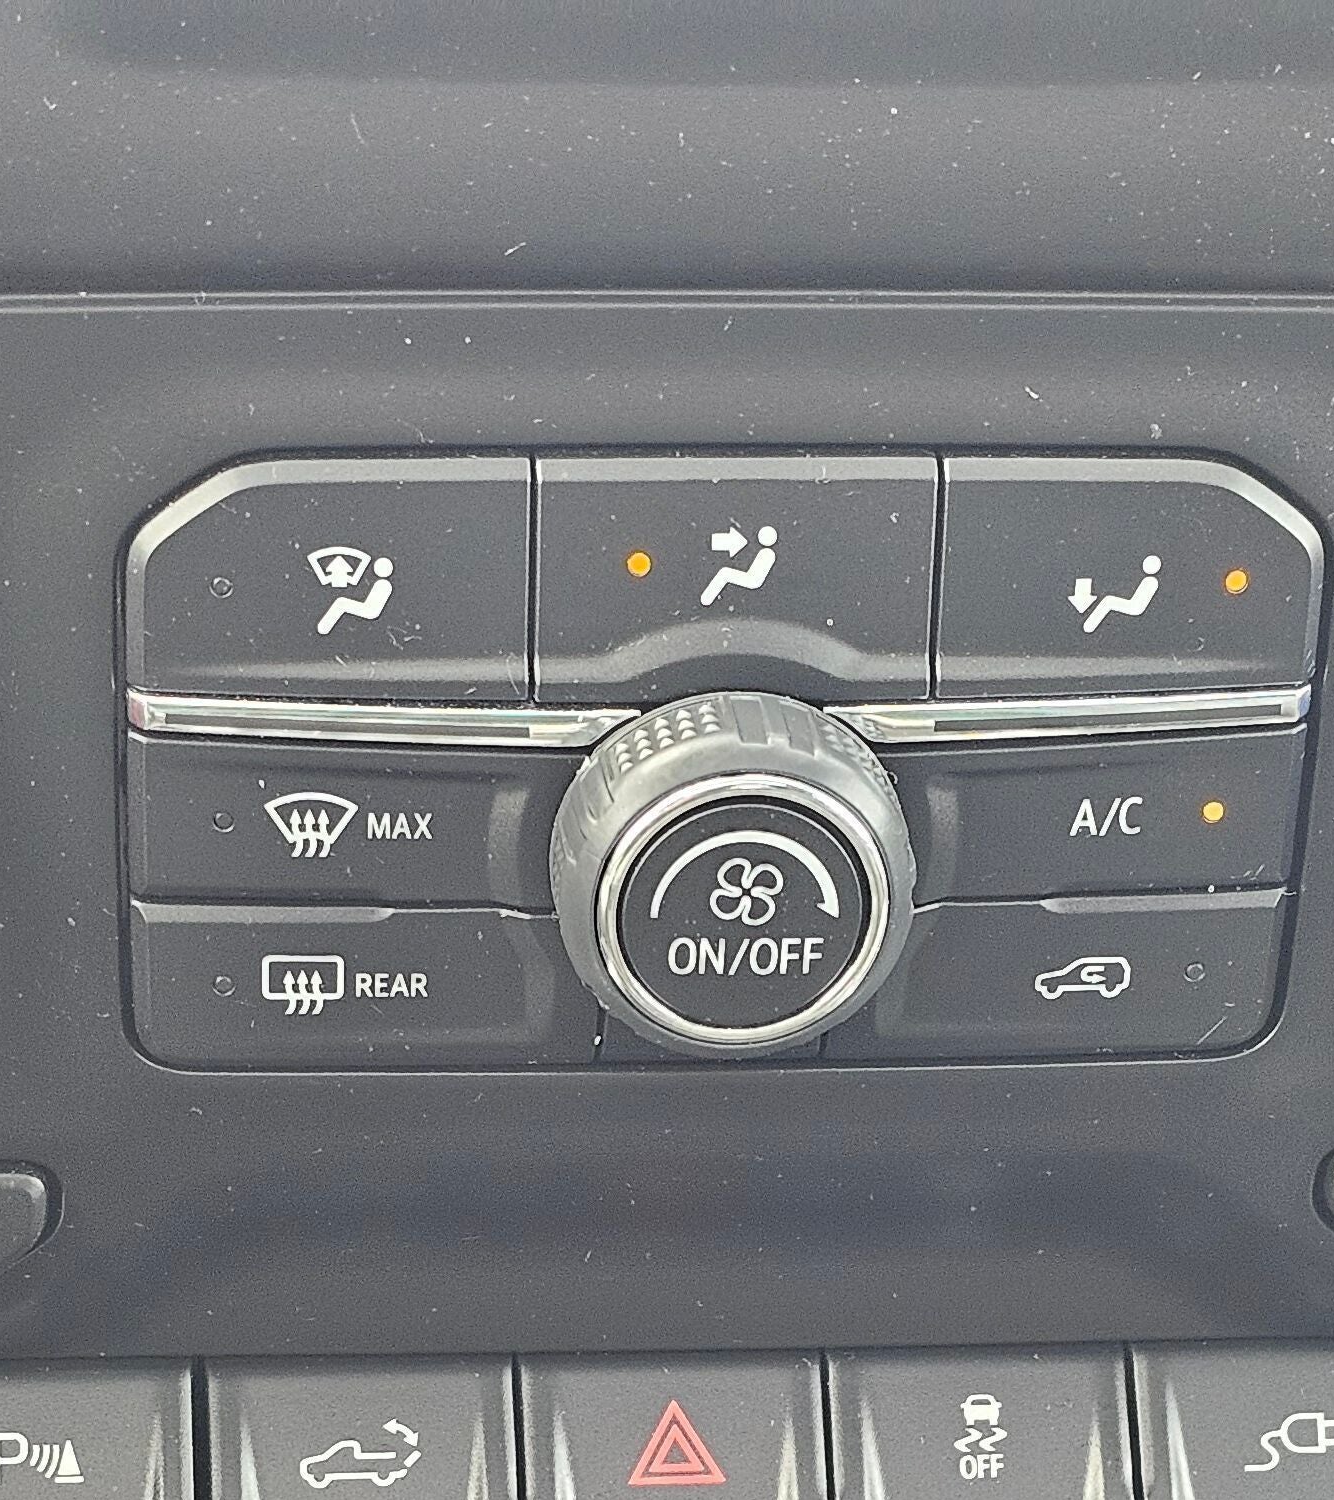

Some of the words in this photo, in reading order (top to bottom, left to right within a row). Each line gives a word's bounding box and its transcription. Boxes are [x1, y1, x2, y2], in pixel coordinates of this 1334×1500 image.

[367, 812, 432, 839] MAX
[1069, 796, 1143, 837] A/C
[668, 937, 824, 976] ON/OFF
[355, 973, 428, 998] REAR
[959, 1453, 1004, 1480] OFF
